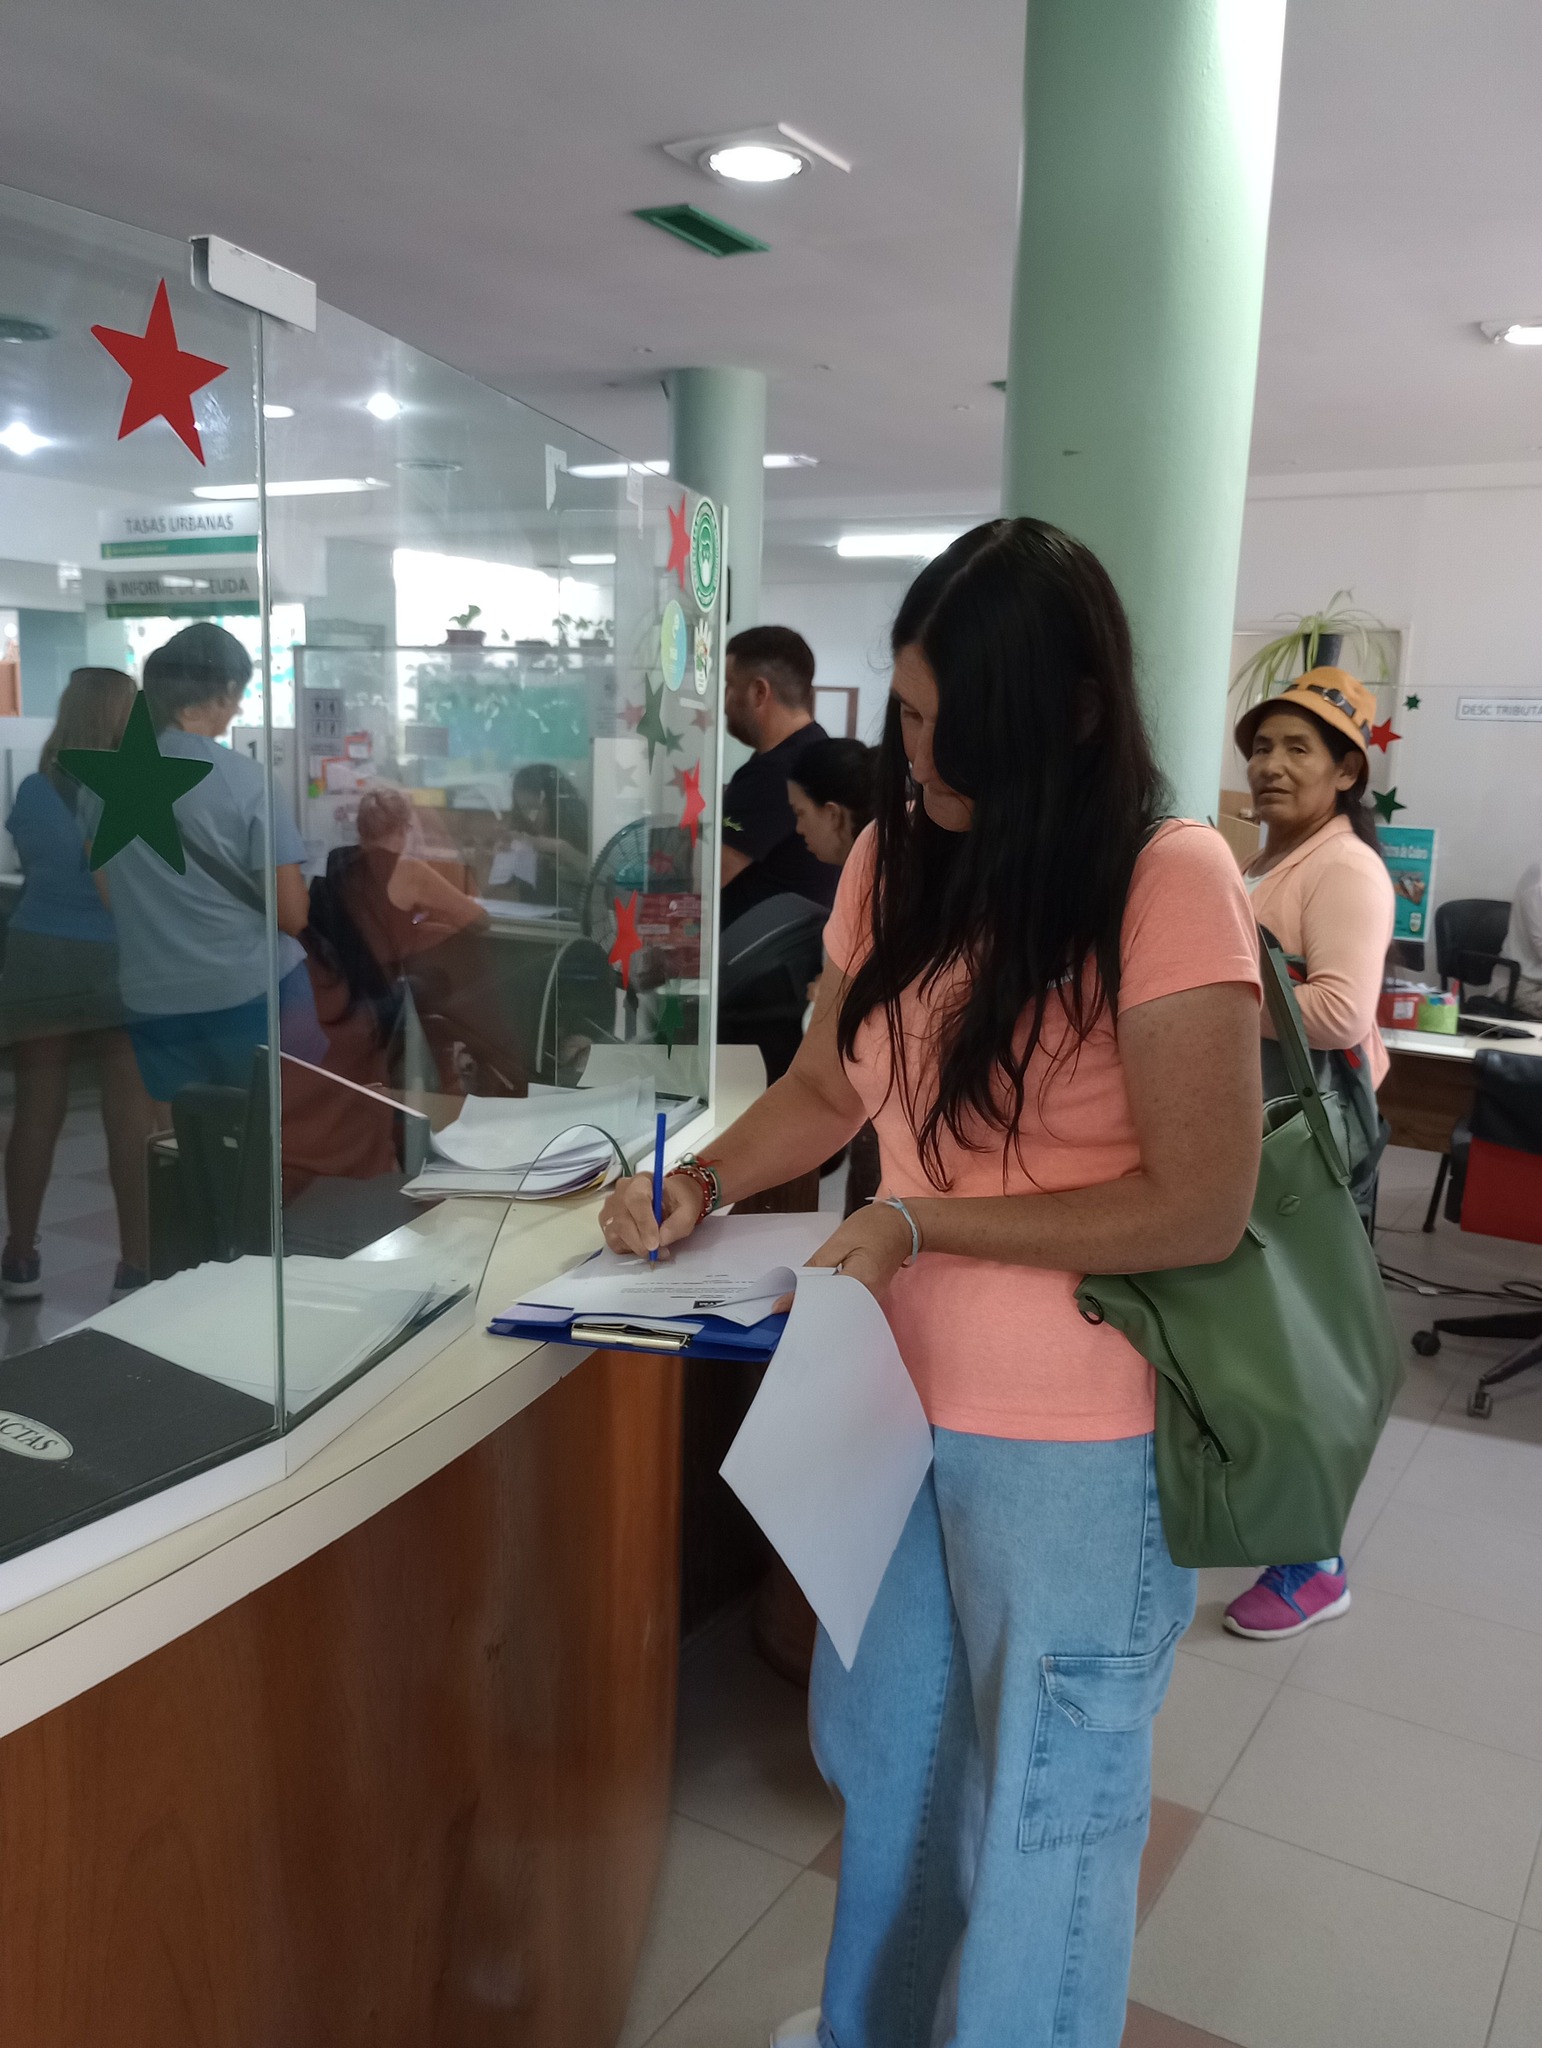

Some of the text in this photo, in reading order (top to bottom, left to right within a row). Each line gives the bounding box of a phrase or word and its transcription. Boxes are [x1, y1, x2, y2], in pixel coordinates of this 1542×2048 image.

[126, 512, 233, 533] TASAS URBANAS
[1461, 704, 1492, 716] DESC
